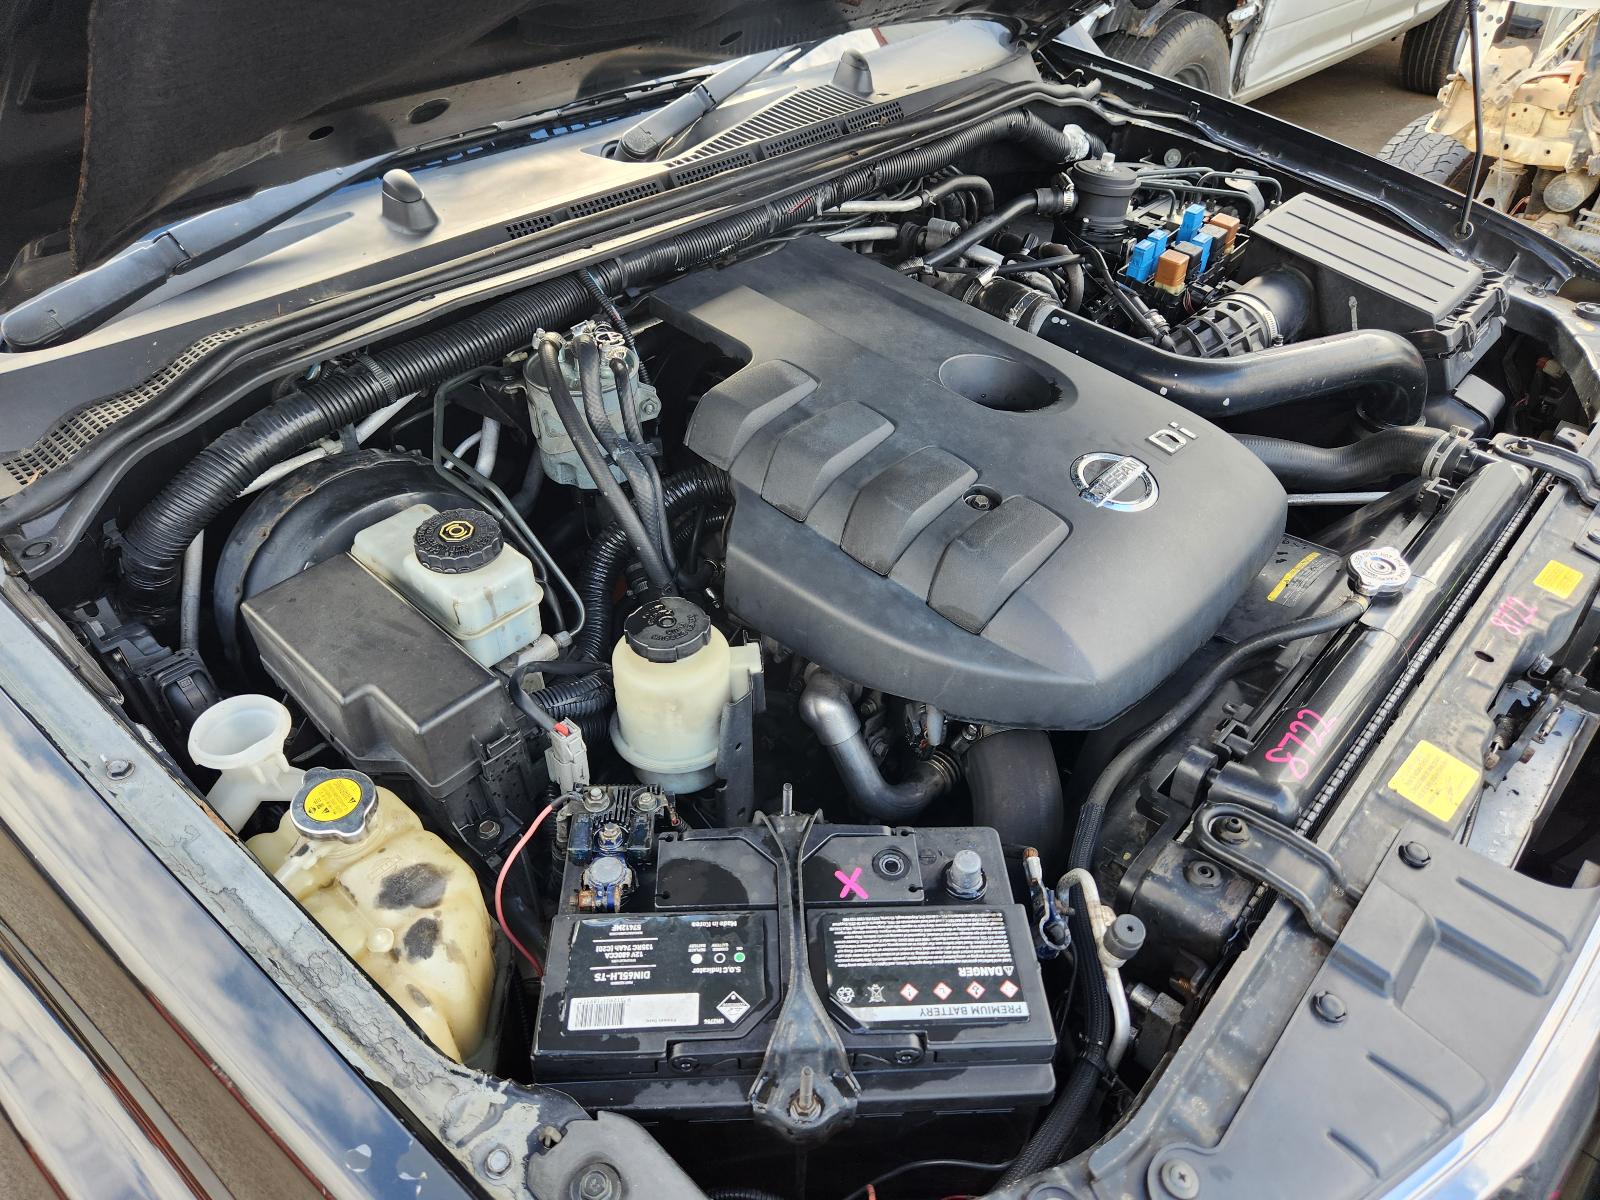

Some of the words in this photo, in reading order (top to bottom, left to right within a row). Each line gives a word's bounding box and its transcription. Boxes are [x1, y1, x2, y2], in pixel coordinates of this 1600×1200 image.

[1146, 421, 1198, 456] Di
[1090, 460, 1141, 499] NISSAN
[1264, 708, 1337, 781] 8722
[691, 920, 711, 928] Korea
[593, 970, 651, 982] DIN65LH-TS
[691, 966, 722, 974] Indicator
[957, 965, 1004, 977] DANGER
[919, 1005, 968, 1017] BATTERY
[971, 1004, 1023, 1016] PREMIUM
